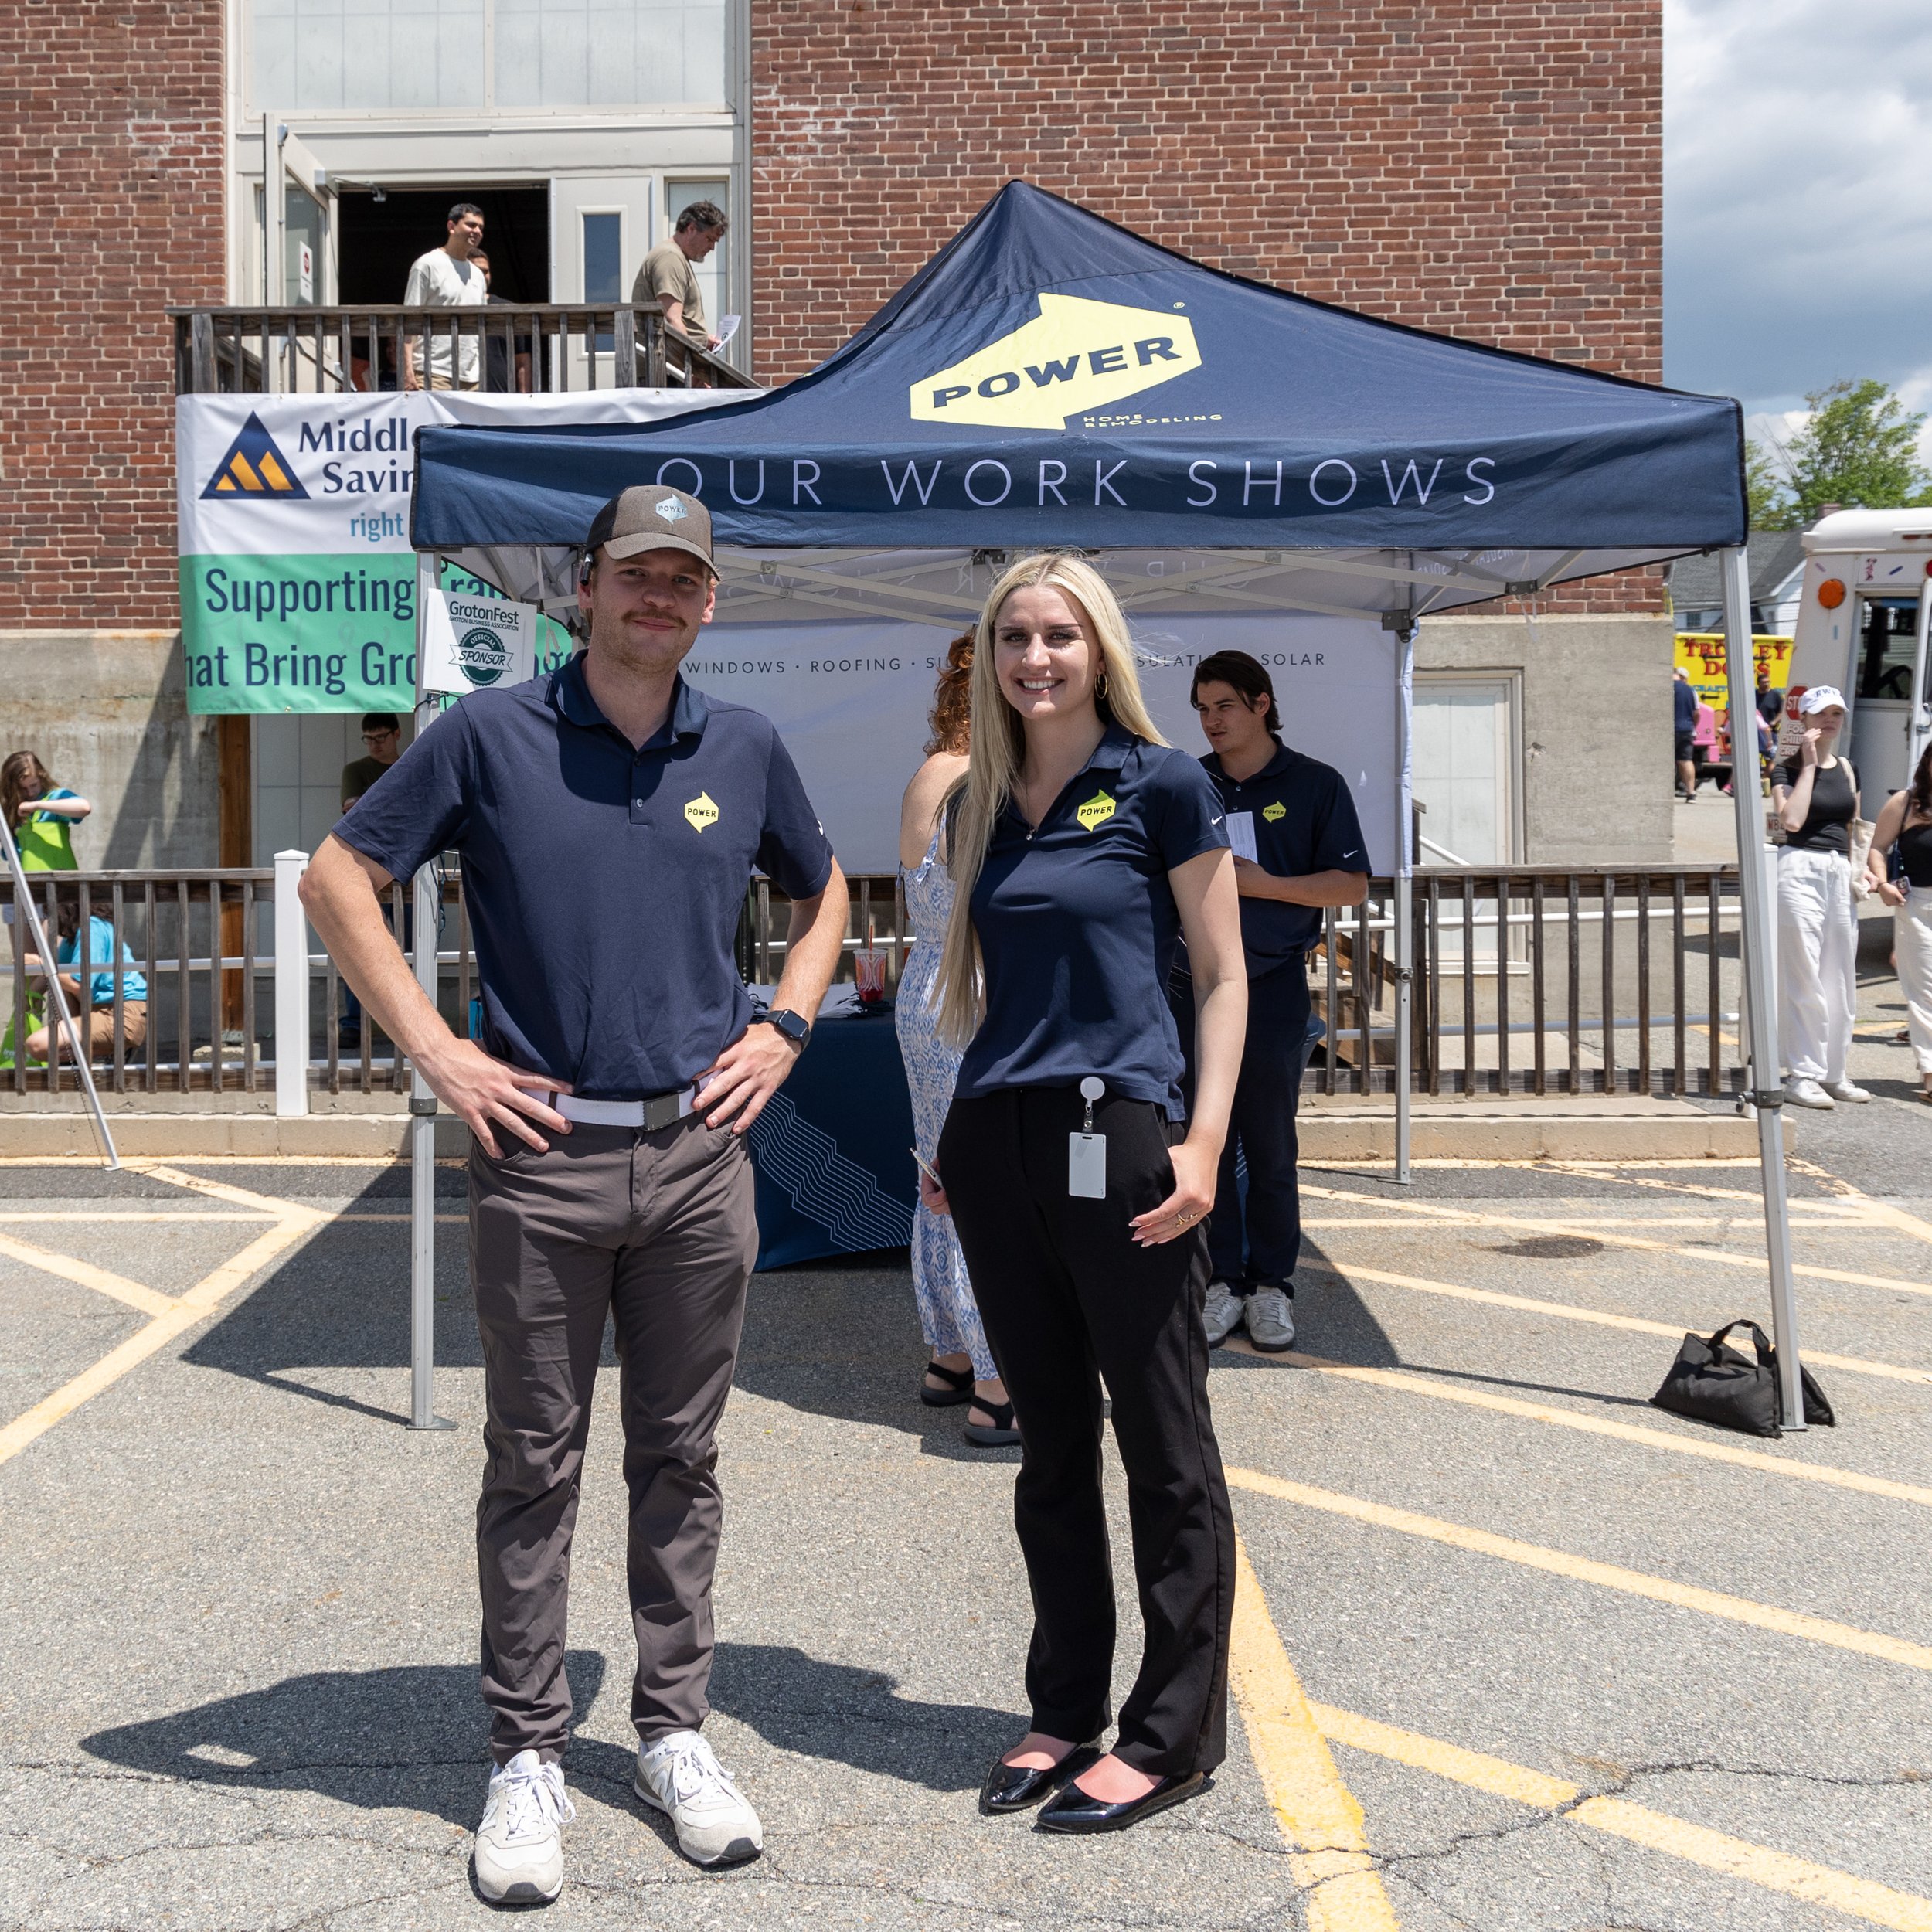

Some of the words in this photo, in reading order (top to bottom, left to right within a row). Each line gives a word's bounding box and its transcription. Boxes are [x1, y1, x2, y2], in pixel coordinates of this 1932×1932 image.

[933, 336, 1182, 408] POWER
[1083, 413, 1143, 422] HOME
[1084, 414, 1223, 428] REMODELING
[299, 417, 414, 453] Middl
[656, 458, 822, 505] OUR
[880, 459, 1129, 506] WORK
[1186, 457, 1495, 507] SHOWS
[658, 505, 687, 515] POWER
[350, 511, 404, 542] right
[206, 568, 416, 622] Supporting
[449, 600, 519, 625] GrotonFest
[468, 618, 490, 627] BUSINESS
[491, 621, 519, 631] ASSOCIATION
[470, 634, 496, 648] OFFICIAL
[1684, 638, 1789, 660] TROEY
[458, 650, 506, 666] SPONSOR
[685, 660, 785, 674] WINDOWS
[811, 658, 901, 673] ROOFING
[1136, 654, 1202, 668] SULATI
[1260, 652, 1325, 666] SOLAR
[245, 642, 347, 696] Bring
[361, 641, 416, 686] Gro
[1704, 661, 1770, 675] DS
[1787, 696, 1801, 710] ST
[687, 808, 716, 818] POWER
[1080, 805, 1112, 817] POWER
